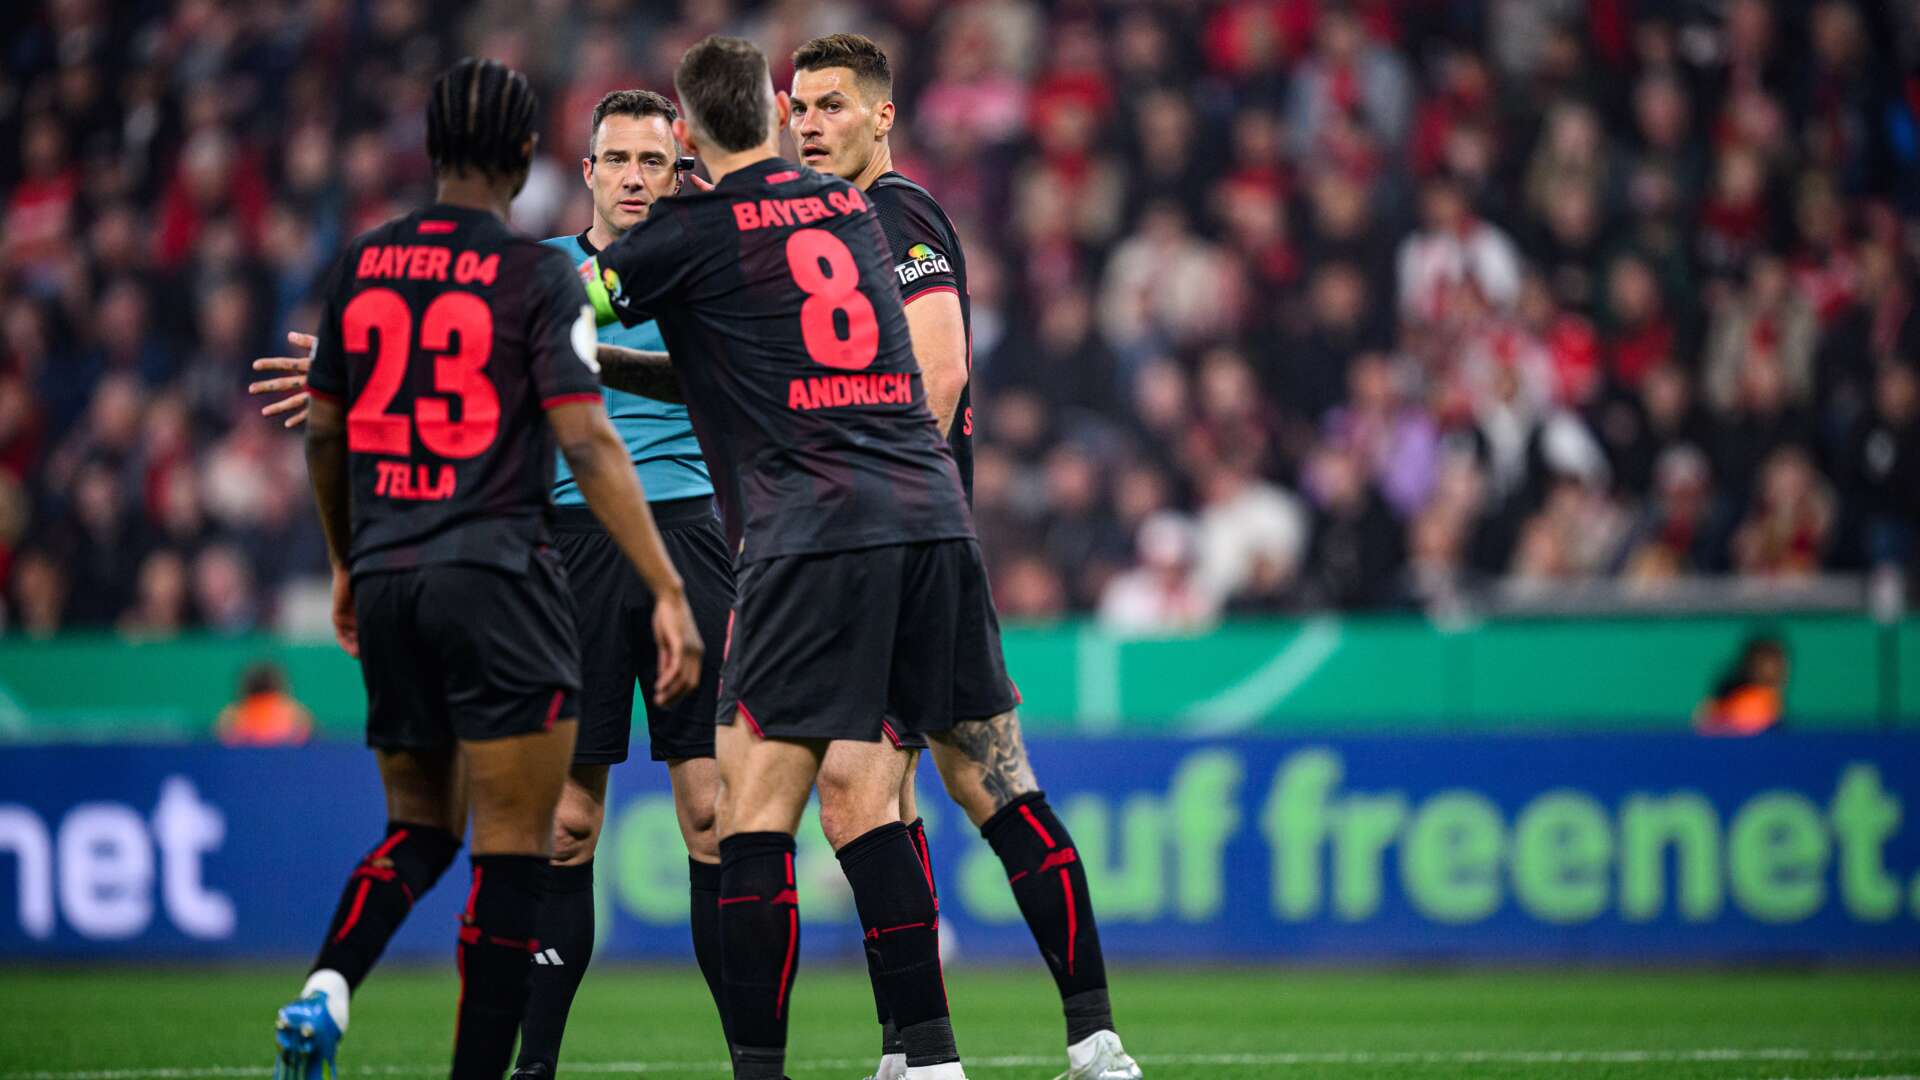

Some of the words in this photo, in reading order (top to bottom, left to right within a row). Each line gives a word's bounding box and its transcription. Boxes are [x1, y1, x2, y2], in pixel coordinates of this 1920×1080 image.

[732, 196, 836, 231] BAYER
[828, 187, 868, 216] 04
[356, 245, 451, 282] BAYER
[454, 251, 501, 286] 04
[894, 255, 951, 286] Talcid
[786, 228, 880, 371] 8
[341, 287, 501, 459] 23
[788, 373, 913, 411] ANDRICH
[375, 461, 457, 500] TELLA
